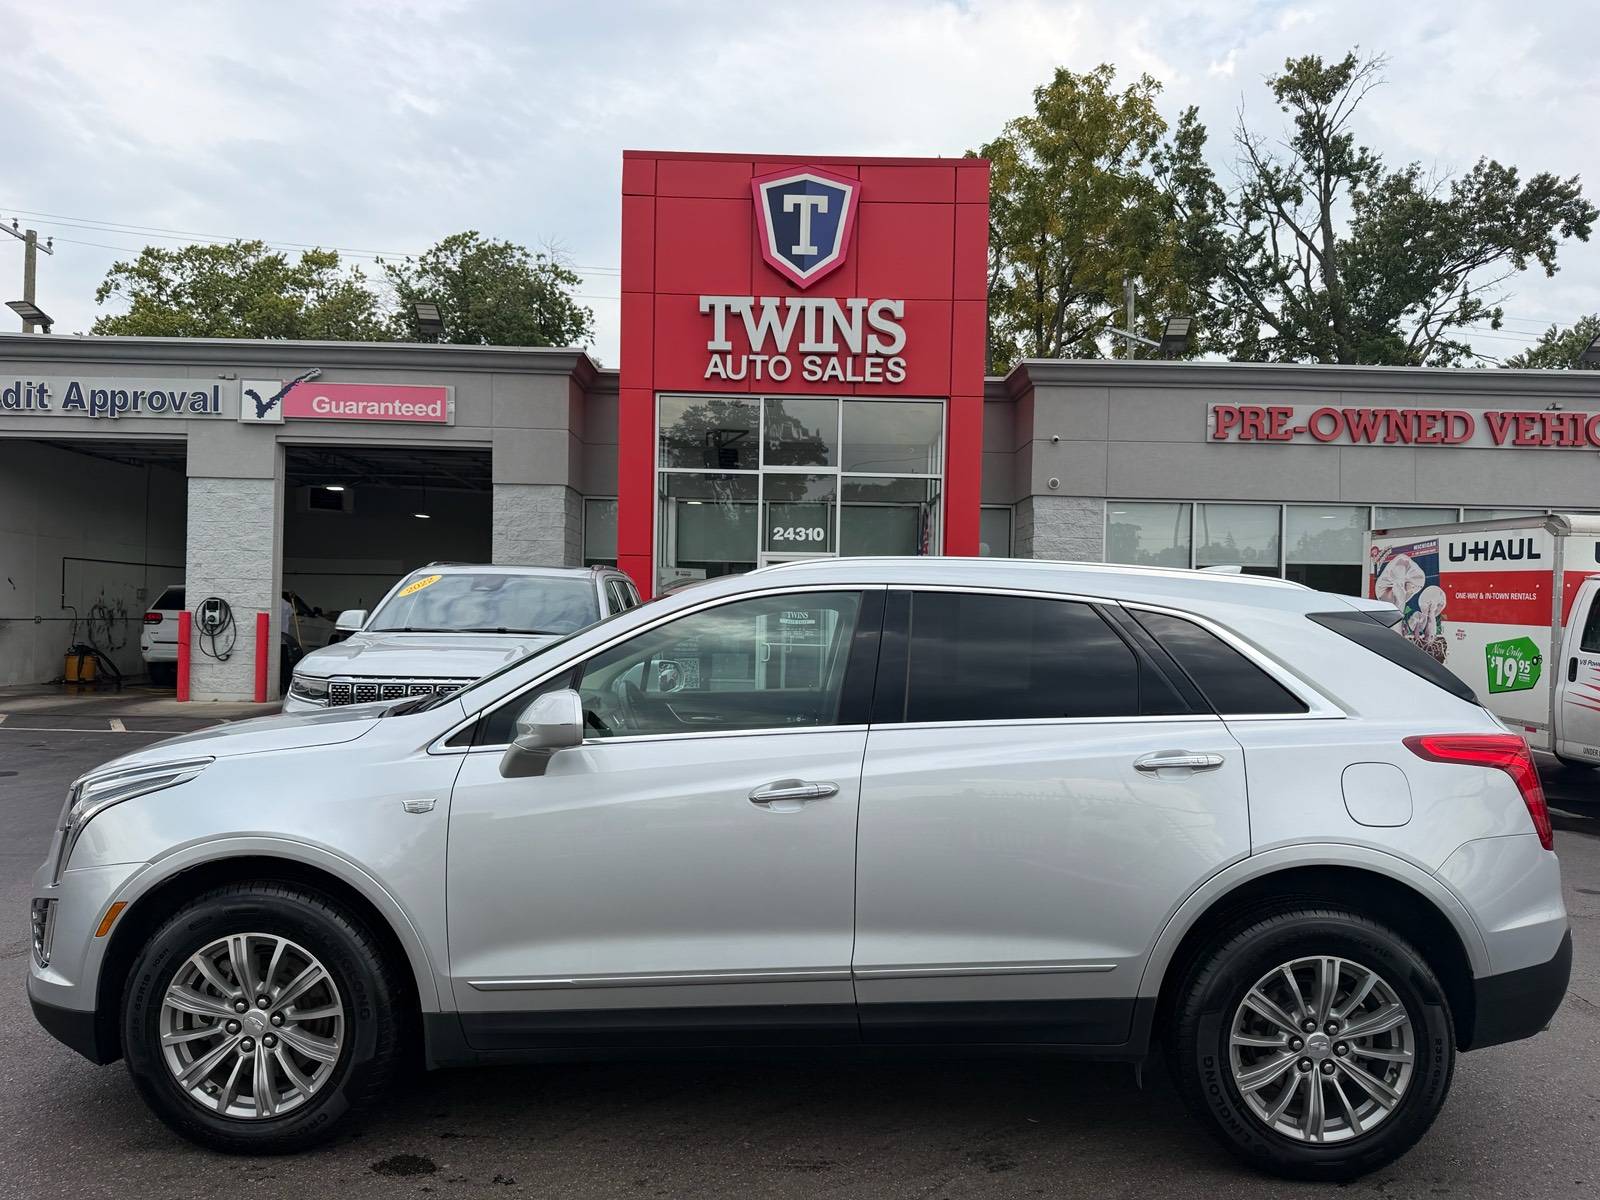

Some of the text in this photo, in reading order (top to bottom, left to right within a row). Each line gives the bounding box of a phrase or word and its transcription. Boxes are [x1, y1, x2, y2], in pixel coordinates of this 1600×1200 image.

[783, 194, 829, 255] T
[699, 295, 907, 355] TWINS
[703, 353, 907, 383] AUTO SALES
[61, 381, 221, 417] Approval
[312, 396, 442, 418] Guaranteed
[1213, 404, 1475, 445] PRE-OWNED
[772, 526, 825, 541] 24310
[1448, 538, 1541, 562] U-HAUL
[1455, 592, 1478, 600] ONE-WAY
[1485, 592, 1510, 600] IN-TOWN
[1511, 592, 1537, 600] RENTALS
[1506, 645, 1524, 661] Only
